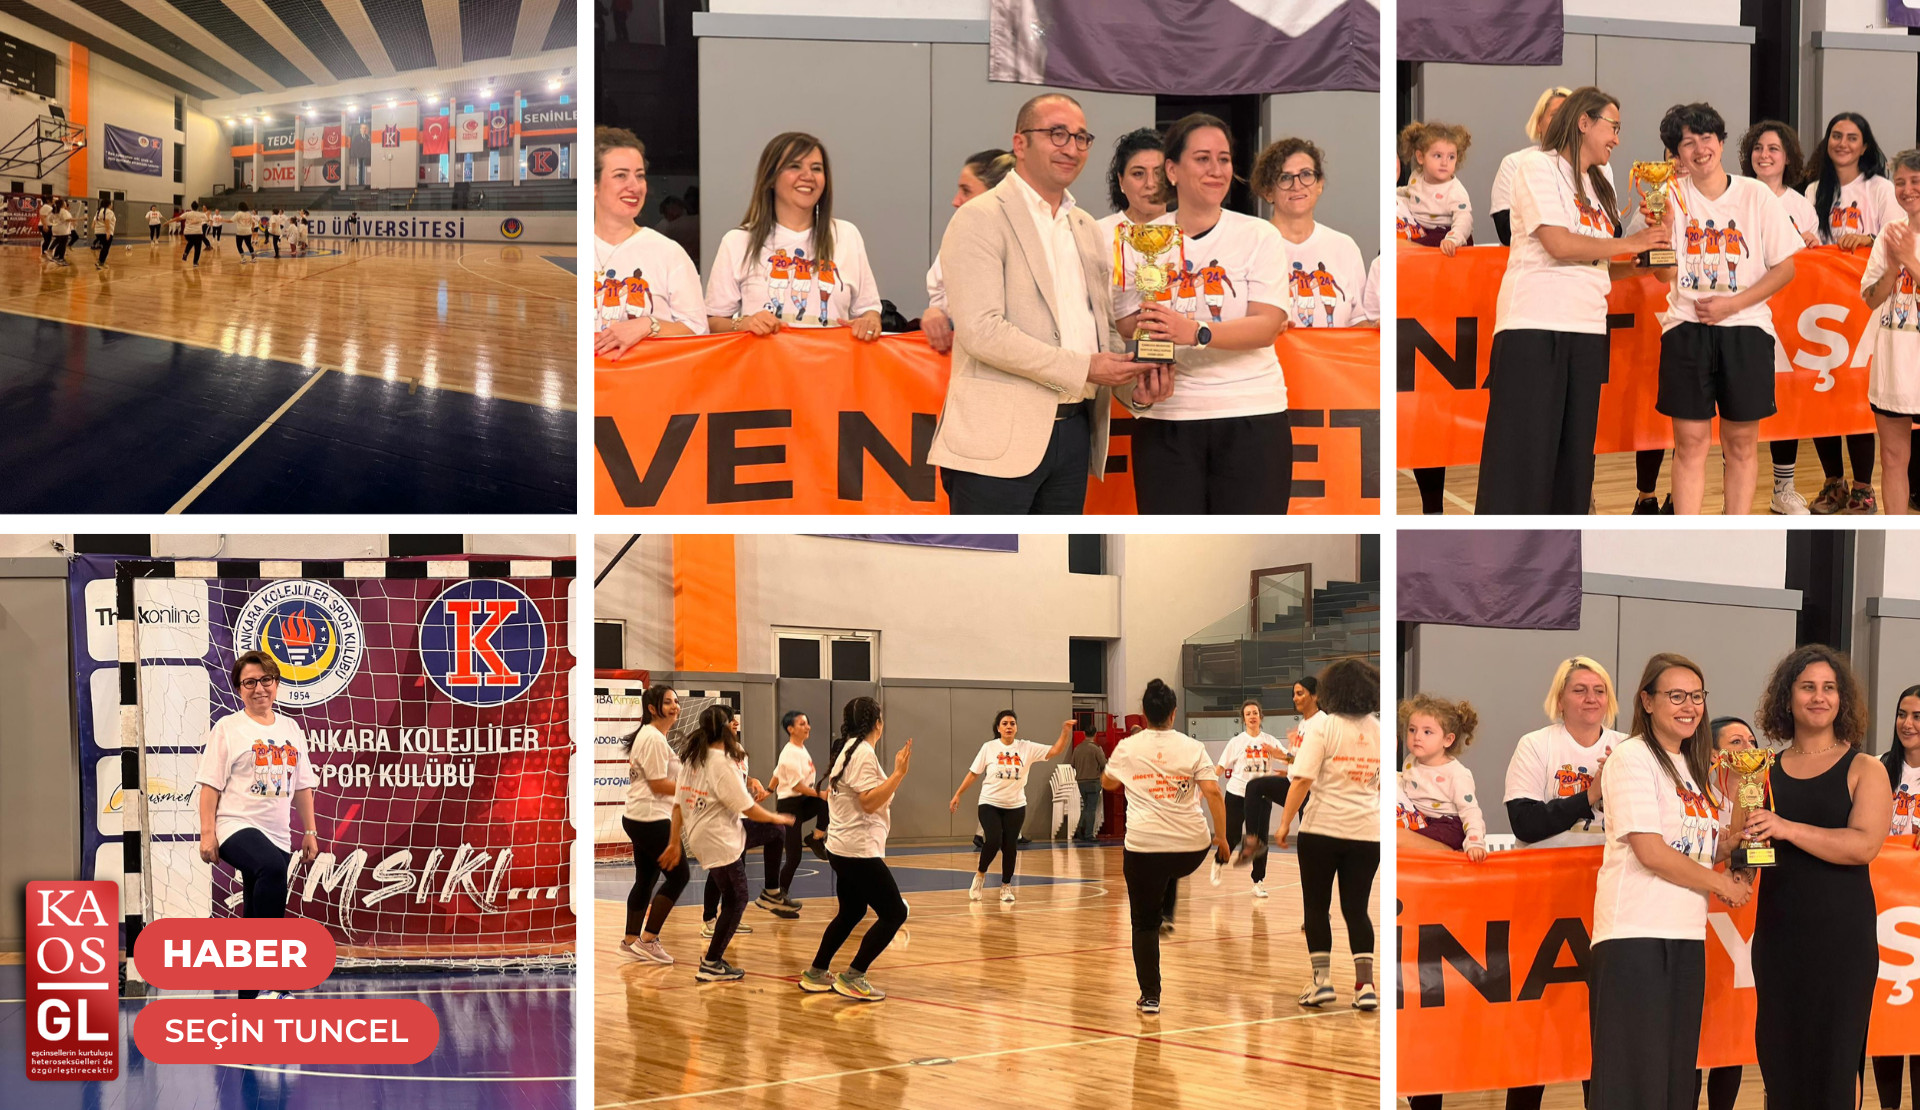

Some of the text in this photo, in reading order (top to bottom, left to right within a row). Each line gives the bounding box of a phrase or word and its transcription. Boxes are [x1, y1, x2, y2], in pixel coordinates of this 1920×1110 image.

[267, 131, 295, 147] TEDÜ
[385, 132, 396, 146] K
[532, 151, 553, 173] K
[326, 163, 340, 181] K
[308, 220, 326, 235] ED
[1689, 231, 1699, 241] 20
[1709, 236, 1718, 246] 11
[1728, 233, 1738, 243] 24
[775, 259, 787, 267] 20
[1207, 271, 1219, 283] 24
[1300, 279, 1310, 288] 11
[1320, 276, 1331, 285] 24
[608, 285, 618, 297] 11
[630, 282, 643, 293] 24
[594, 409, 793, 508] VE
[95, 605, 200, 626] Thkonline
[328, 599, 353, 630] SPOR
[240, 605, 265, 651] ANKARA
[444, 600, 519, 686] K
[334, 631, 356, 680] KULÜBÜ
[289, 691, 310, 700] 1954
[401, 723, 540, 752] KOLEJLİLER
[594, 736, 629, 744] ADOBA
[379, 758, 475, 788] KULÜBÜ
[1562, 775, 1573, 783] 20
[1901, 799, 1908, 809] 11
